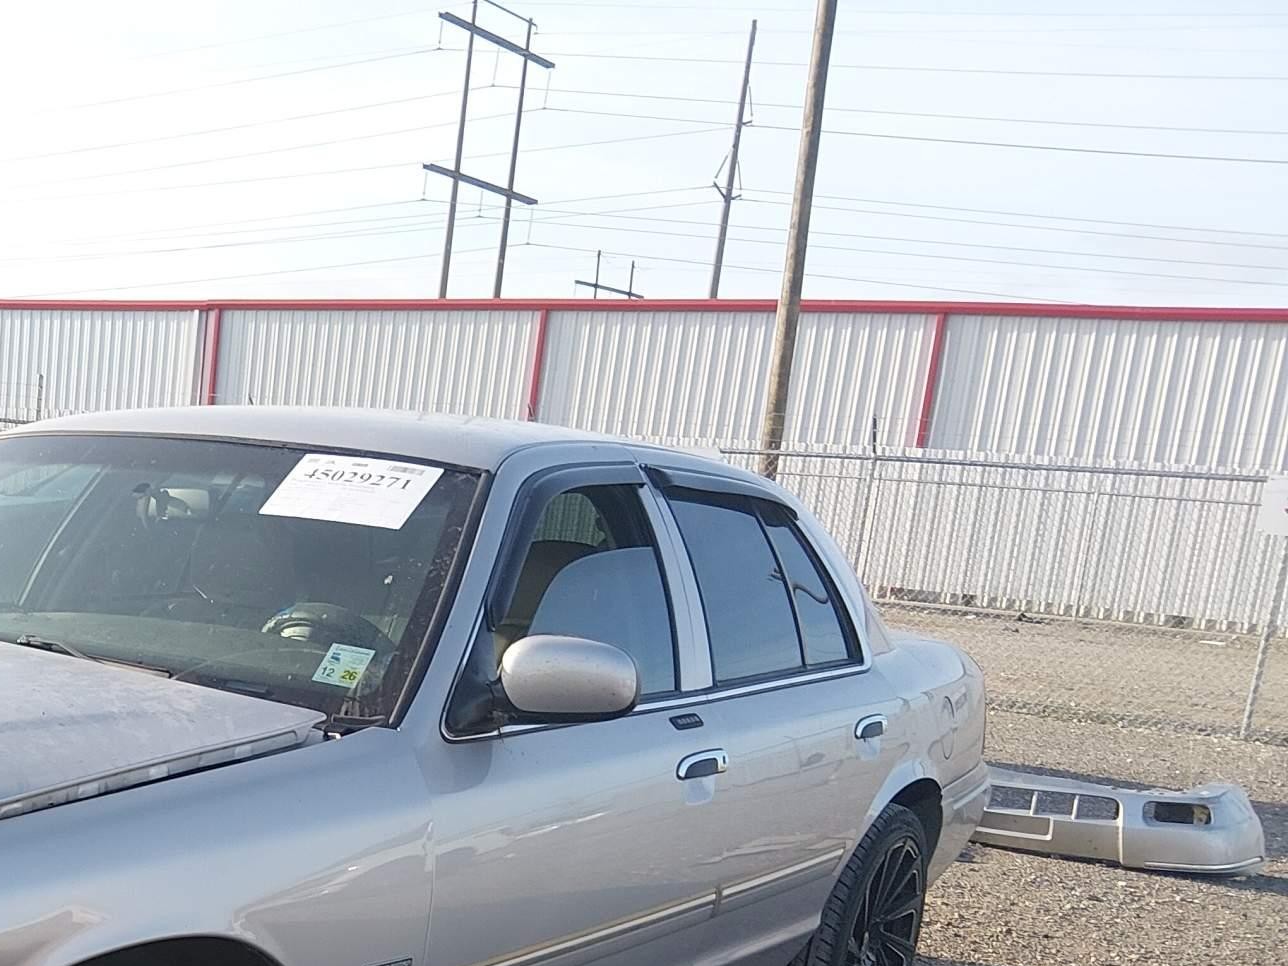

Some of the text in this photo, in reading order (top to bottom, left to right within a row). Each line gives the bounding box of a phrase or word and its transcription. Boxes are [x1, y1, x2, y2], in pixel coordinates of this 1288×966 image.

[304, 468, 413, 490] 45029271
[321, 666, 335, 678] 12
[341, 670, 357, 681] 26
